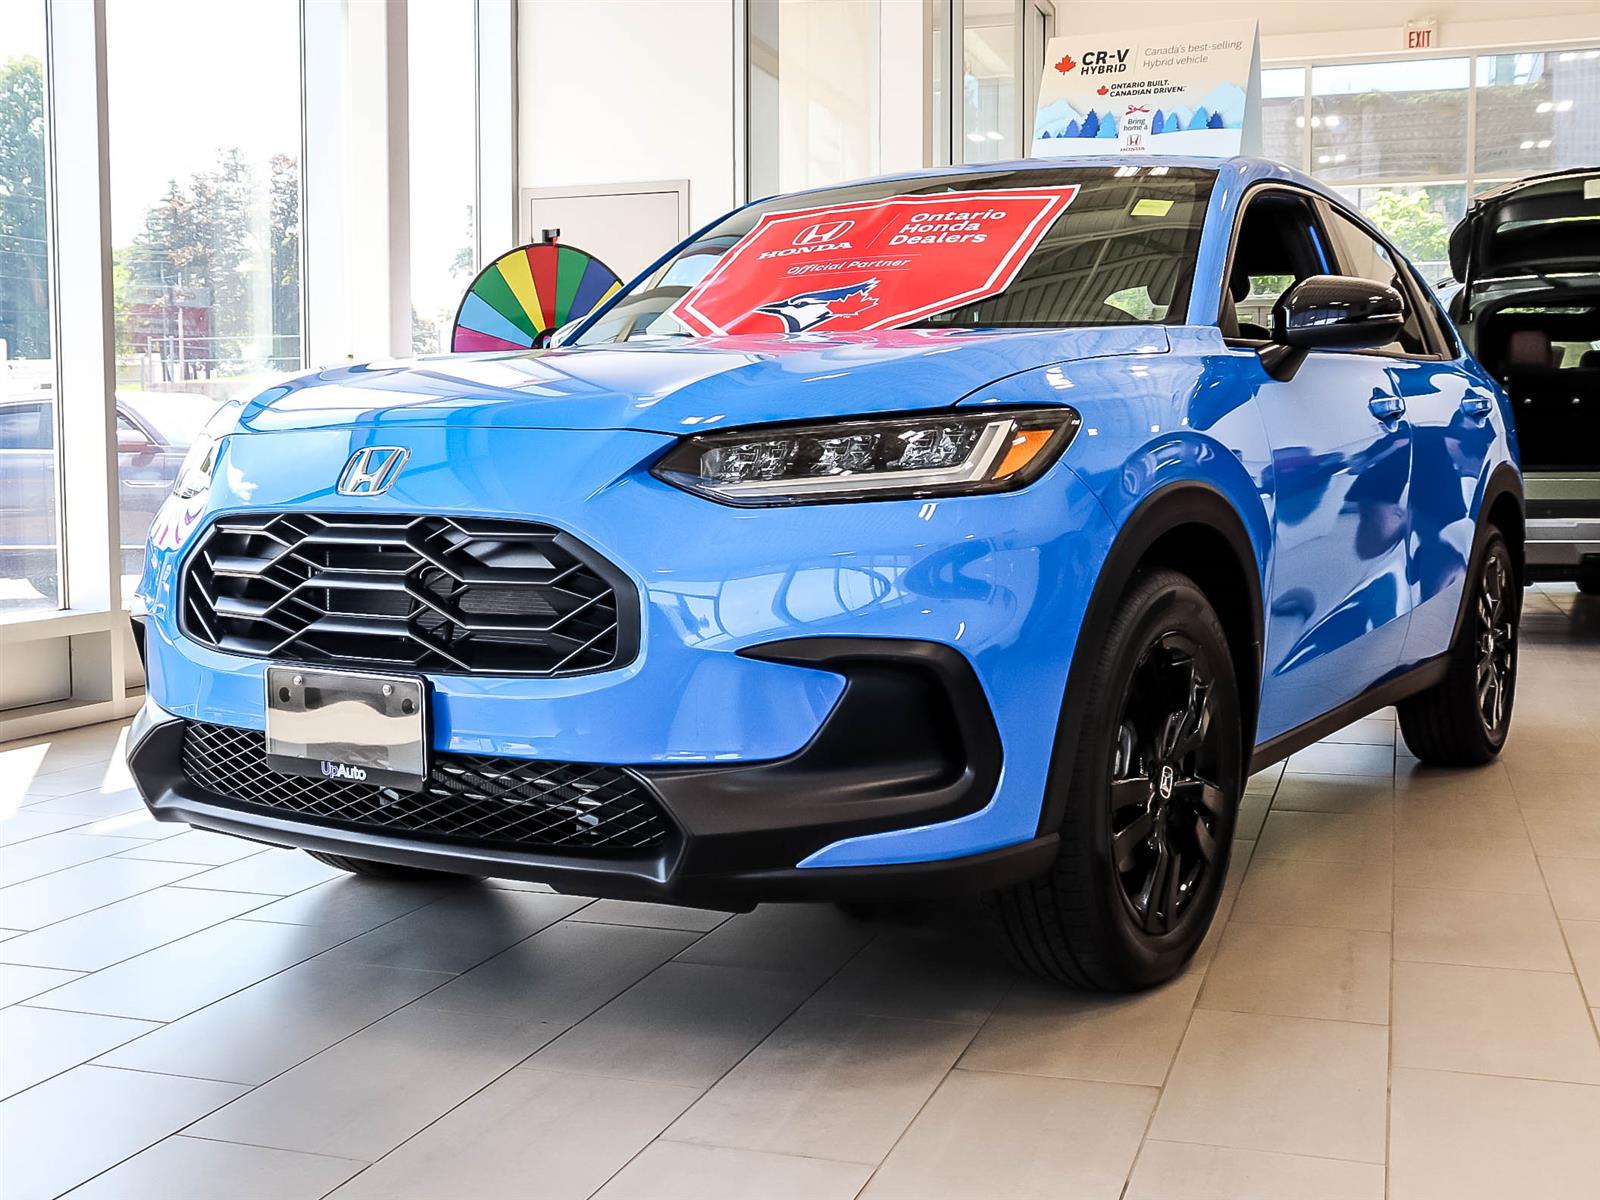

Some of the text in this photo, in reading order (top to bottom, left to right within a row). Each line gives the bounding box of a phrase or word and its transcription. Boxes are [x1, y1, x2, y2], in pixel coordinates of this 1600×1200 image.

[1408, 30, 1432, 48] EXIT
[1144, 40, 1243, 56] Canada's best-selling
[1082, 49, 1129, 65] CR-V
[1143, 55, 1209, 69] Hybrid vehicle
[1080, 64, 1127, 75] HYBRID
[1111, 79, 1170, 90] ONTARIO BUILT.
[1109, 89, 1152, 98] CANADIAN
[1127, 118, 1146, 126] Bring
[911, 209, 1006, 222] Ontario
[900, 220, 980, 233] Honda
[888, 232, 987, 245] Dealers
[758, 242, 852, 260] HONDA
[787, 258, 912, 275] Official Partner
[321, 761, 367, 780] UpAuto
